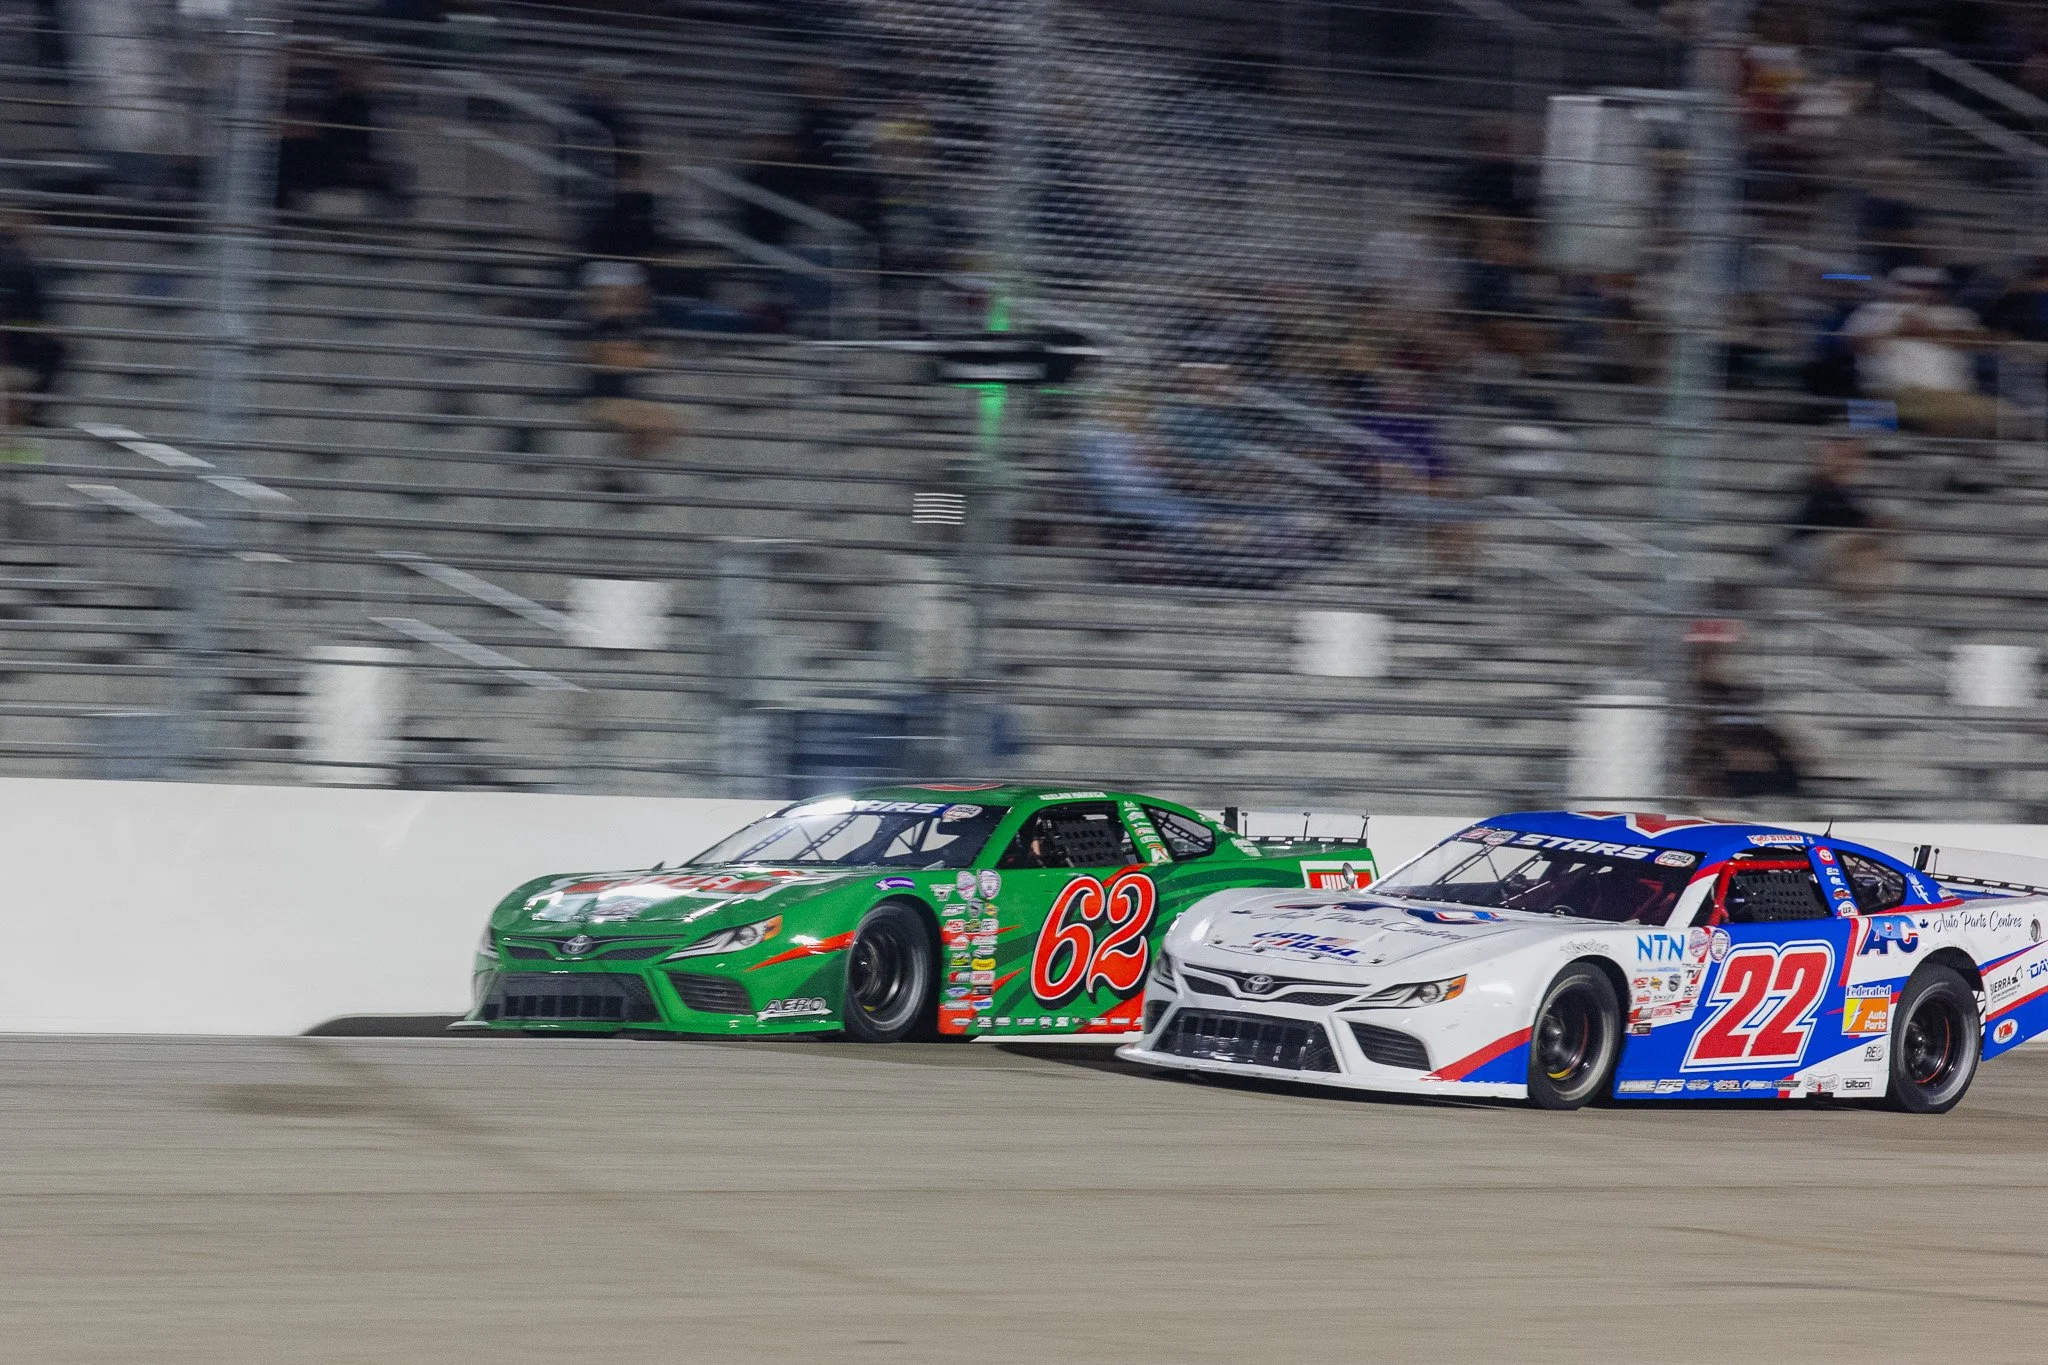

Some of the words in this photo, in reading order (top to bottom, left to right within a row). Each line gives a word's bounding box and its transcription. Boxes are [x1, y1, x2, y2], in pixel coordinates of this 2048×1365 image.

[1512, 833, 1657, 860] STARS
[1934, 912, 1959, 933] Auto
[1960, 911, 1987, 932] Parts
[1989, 910, 2022, 932] Centres
[1031, 873, 1157, 1001] 62
[1857, 915, 1919, 956] APC
[1286, 941, 1360, 957] USA
[1636, 934, 1685, 961] NTN
[1846, 985, 1891, 997] Federated
[1990, 976, 2012, 996] SIERRA
[761, 996, 828, 1013] AERO
[1686, 946, 1831, 1066] 22
[1864, 1020, 1886, 1030] Parts
[1868, 1010, 1887, 1020] Auto
[1845, 1080, 1870, 1089] tilton
